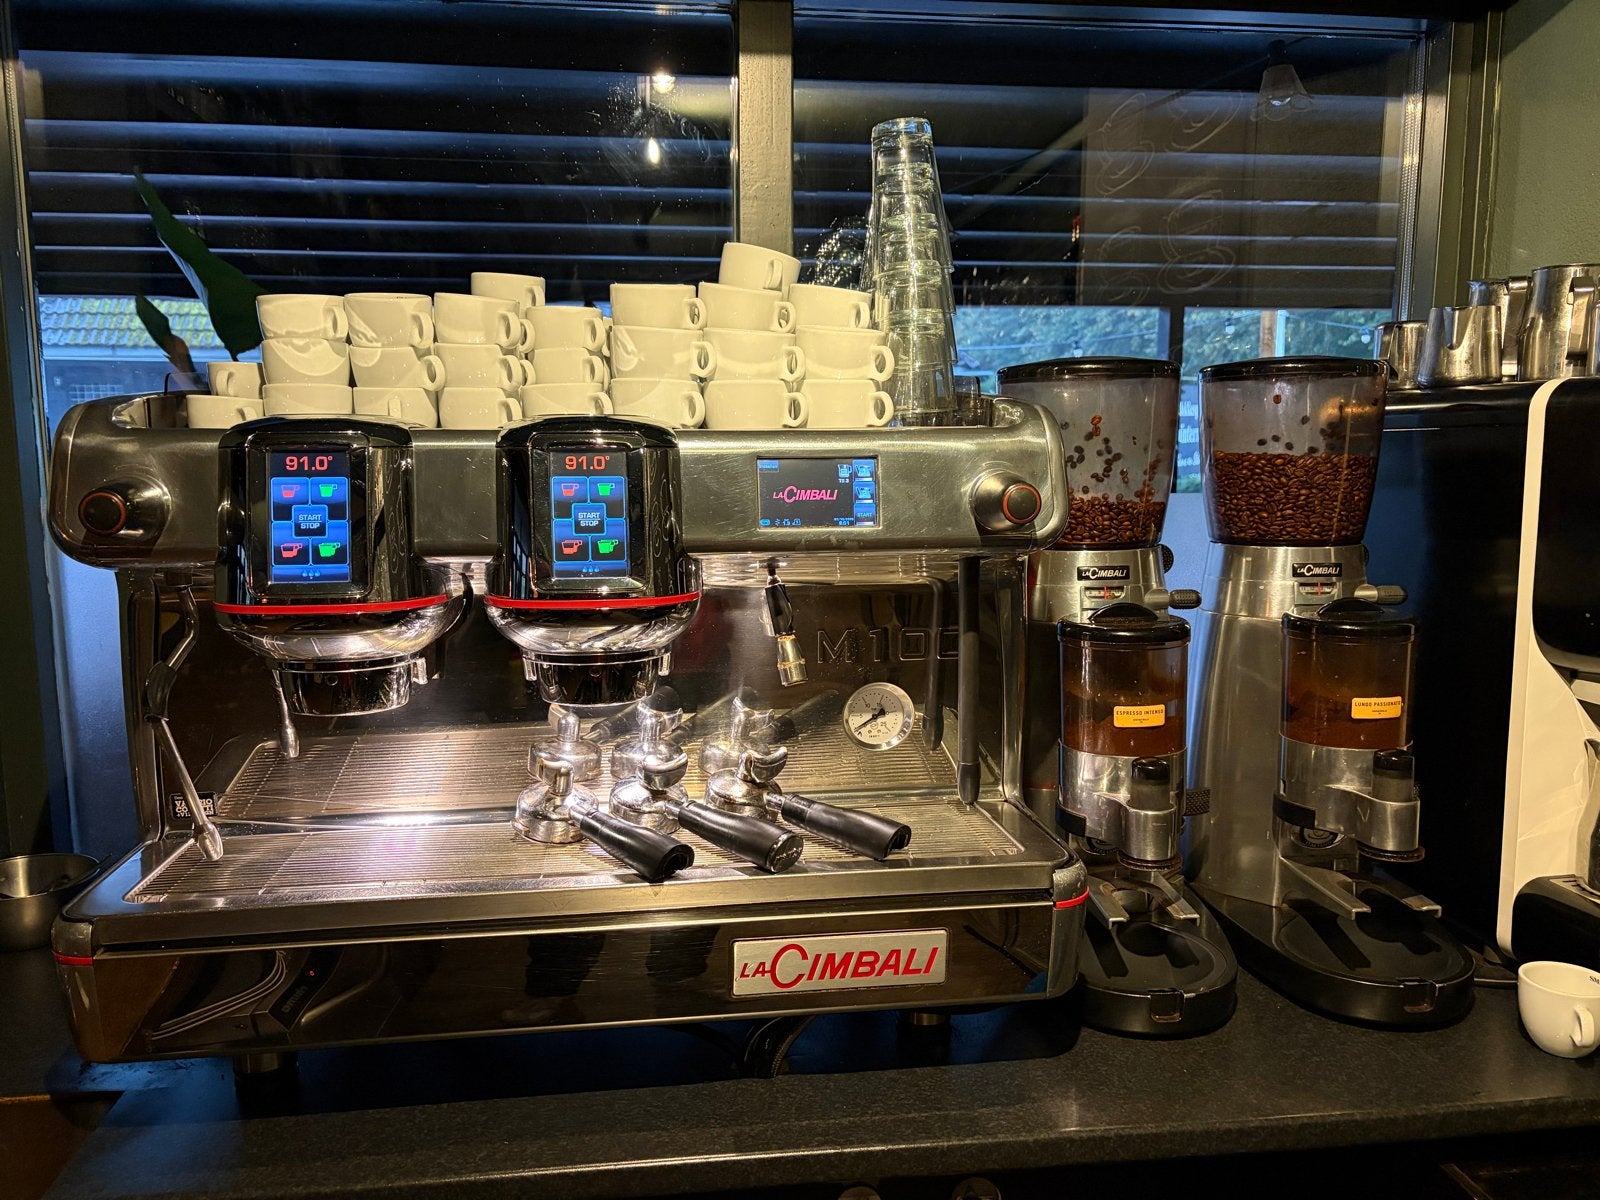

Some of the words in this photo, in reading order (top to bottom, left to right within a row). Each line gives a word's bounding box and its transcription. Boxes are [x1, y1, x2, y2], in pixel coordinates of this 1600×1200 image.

[784, 485, 838, 503] CIMBALI
[1089, 567, 1127, 579] CIMBALI
[1304, 564, 1340, 576] CIMBALI
[740, 961, 770, 978] LA
[770, 943, 939, 989] CIMBALI
